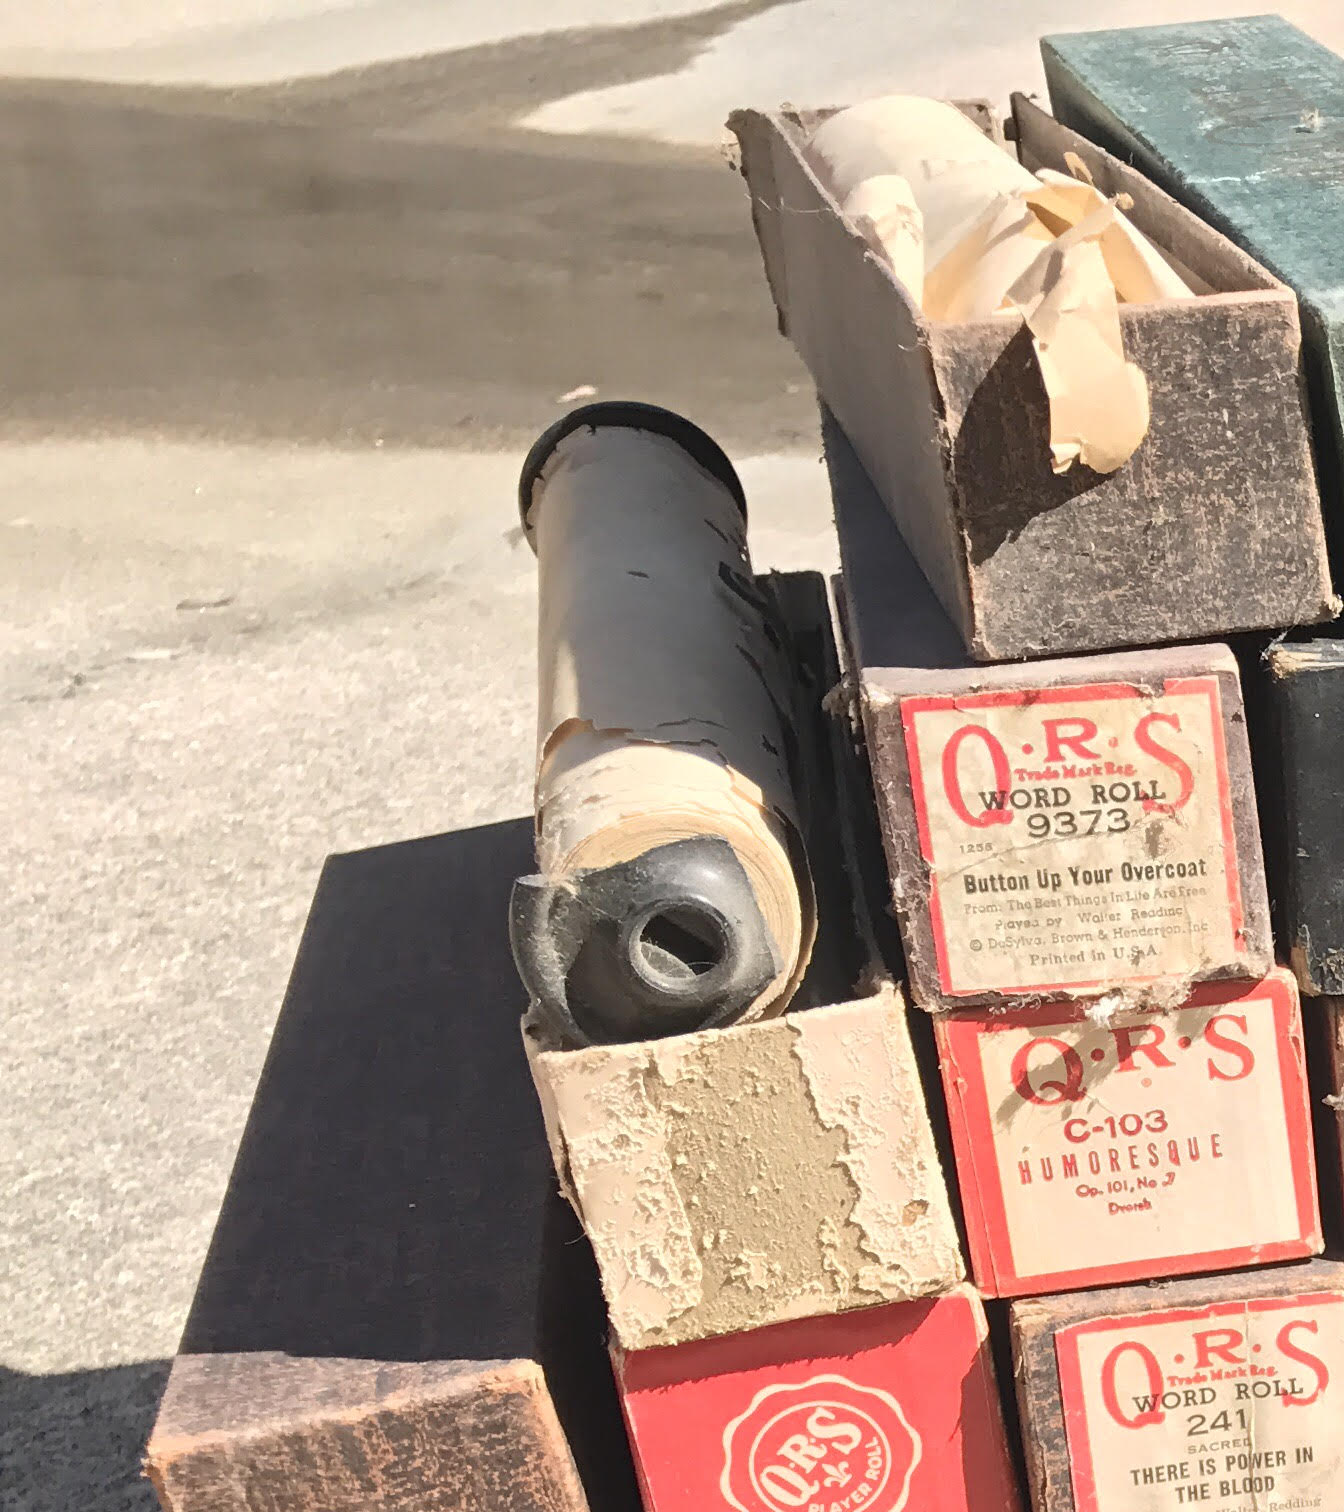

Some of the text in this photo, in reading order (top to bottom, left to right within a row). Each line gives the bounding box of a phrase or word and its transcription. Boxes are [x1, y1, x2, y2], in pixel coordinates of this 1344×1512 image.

[978, 780, 1166, 811] WORD ROLL
[1027, 810, 1131, 839] 9373
[963, 859, 1207, 894] Button Up Your Overcoat
[1030, 950, 1105, 966] Printed in
[1064, 1109, 1168, 1144] C-103
[1018, 1133, 1223, 1185] HUMORESQUE
[1132, 1378, 1304, 1413] WORD ROLL
[1187, 1409, 1249, 1436] 241
[1188, 1438, 1252, 1454] SACRED
[1130, 1446, 1313, 1486] THERE IS POWER IN
[1175, 1476, 1275, 1503] THE BLOOD
